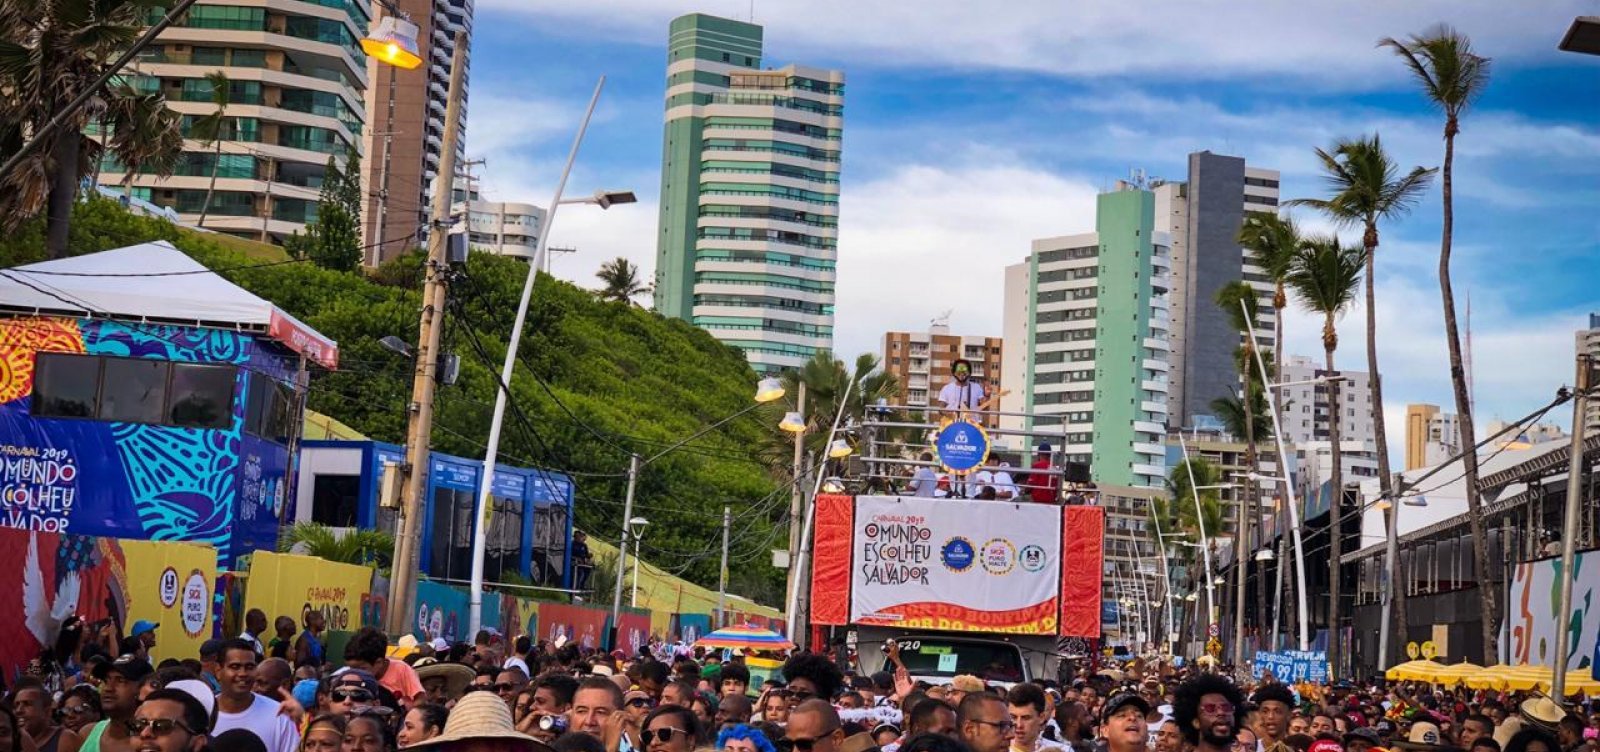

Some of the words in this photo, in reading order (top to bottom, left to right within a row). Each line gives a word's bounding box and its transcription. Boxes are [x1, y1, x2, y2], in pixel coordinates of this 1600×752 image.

[0, 445, 40, 457] ARNAVAL
[41, 447, 68, 461] 2019
[5, 457, 76, 487] MUNDO
[0, 484, 75, 512] COLHEU
[905, 515, 925, 525] 2019
[865, 523, 879, 538] O
[880, 524, 931, 544] MUNDO
[864, 542, 931, 563] ESCOLHEU
[862, 563, 929, 585] SALVADOR
